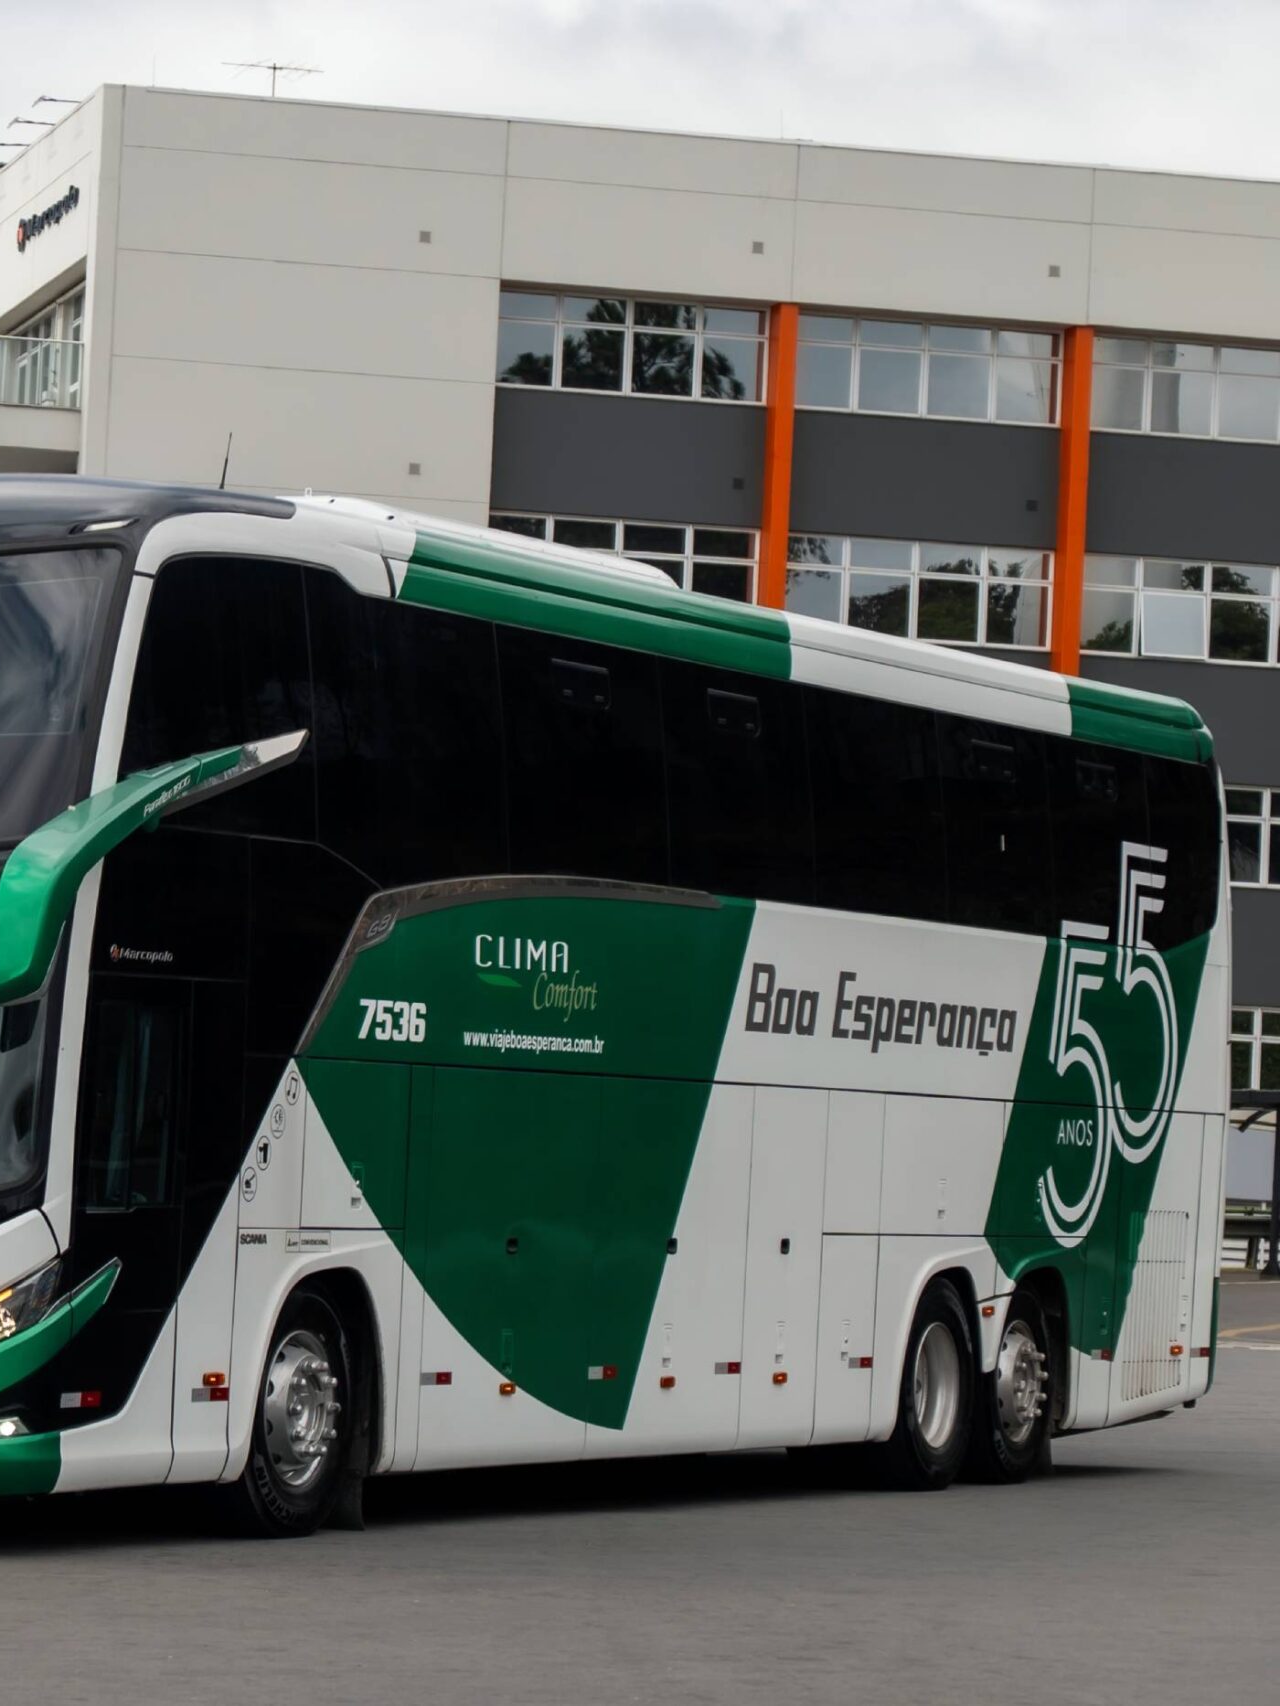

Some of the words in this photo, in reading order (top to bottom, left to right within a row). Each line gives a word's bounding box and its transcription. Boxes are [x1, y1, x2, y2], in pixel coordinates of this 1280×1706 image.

[366, 913, 392, 939] G8
[119, 946, 174, 964] Marcopolo
[474, 933, 570, 974] CLIMA
[532, 969, 599, 1023] Comfort
[744, 962, 820, 1037] Boa
[831, 970, 1018, 1057] Esperança
[357, 998, 428, 1043] 7536
[462, 1027, 605, 1055] www.viajeboaesperanca.com.br
[1056, 1118, 1094, 1147] ANOS
[239, 1233, 268, 1246] SCANIA
